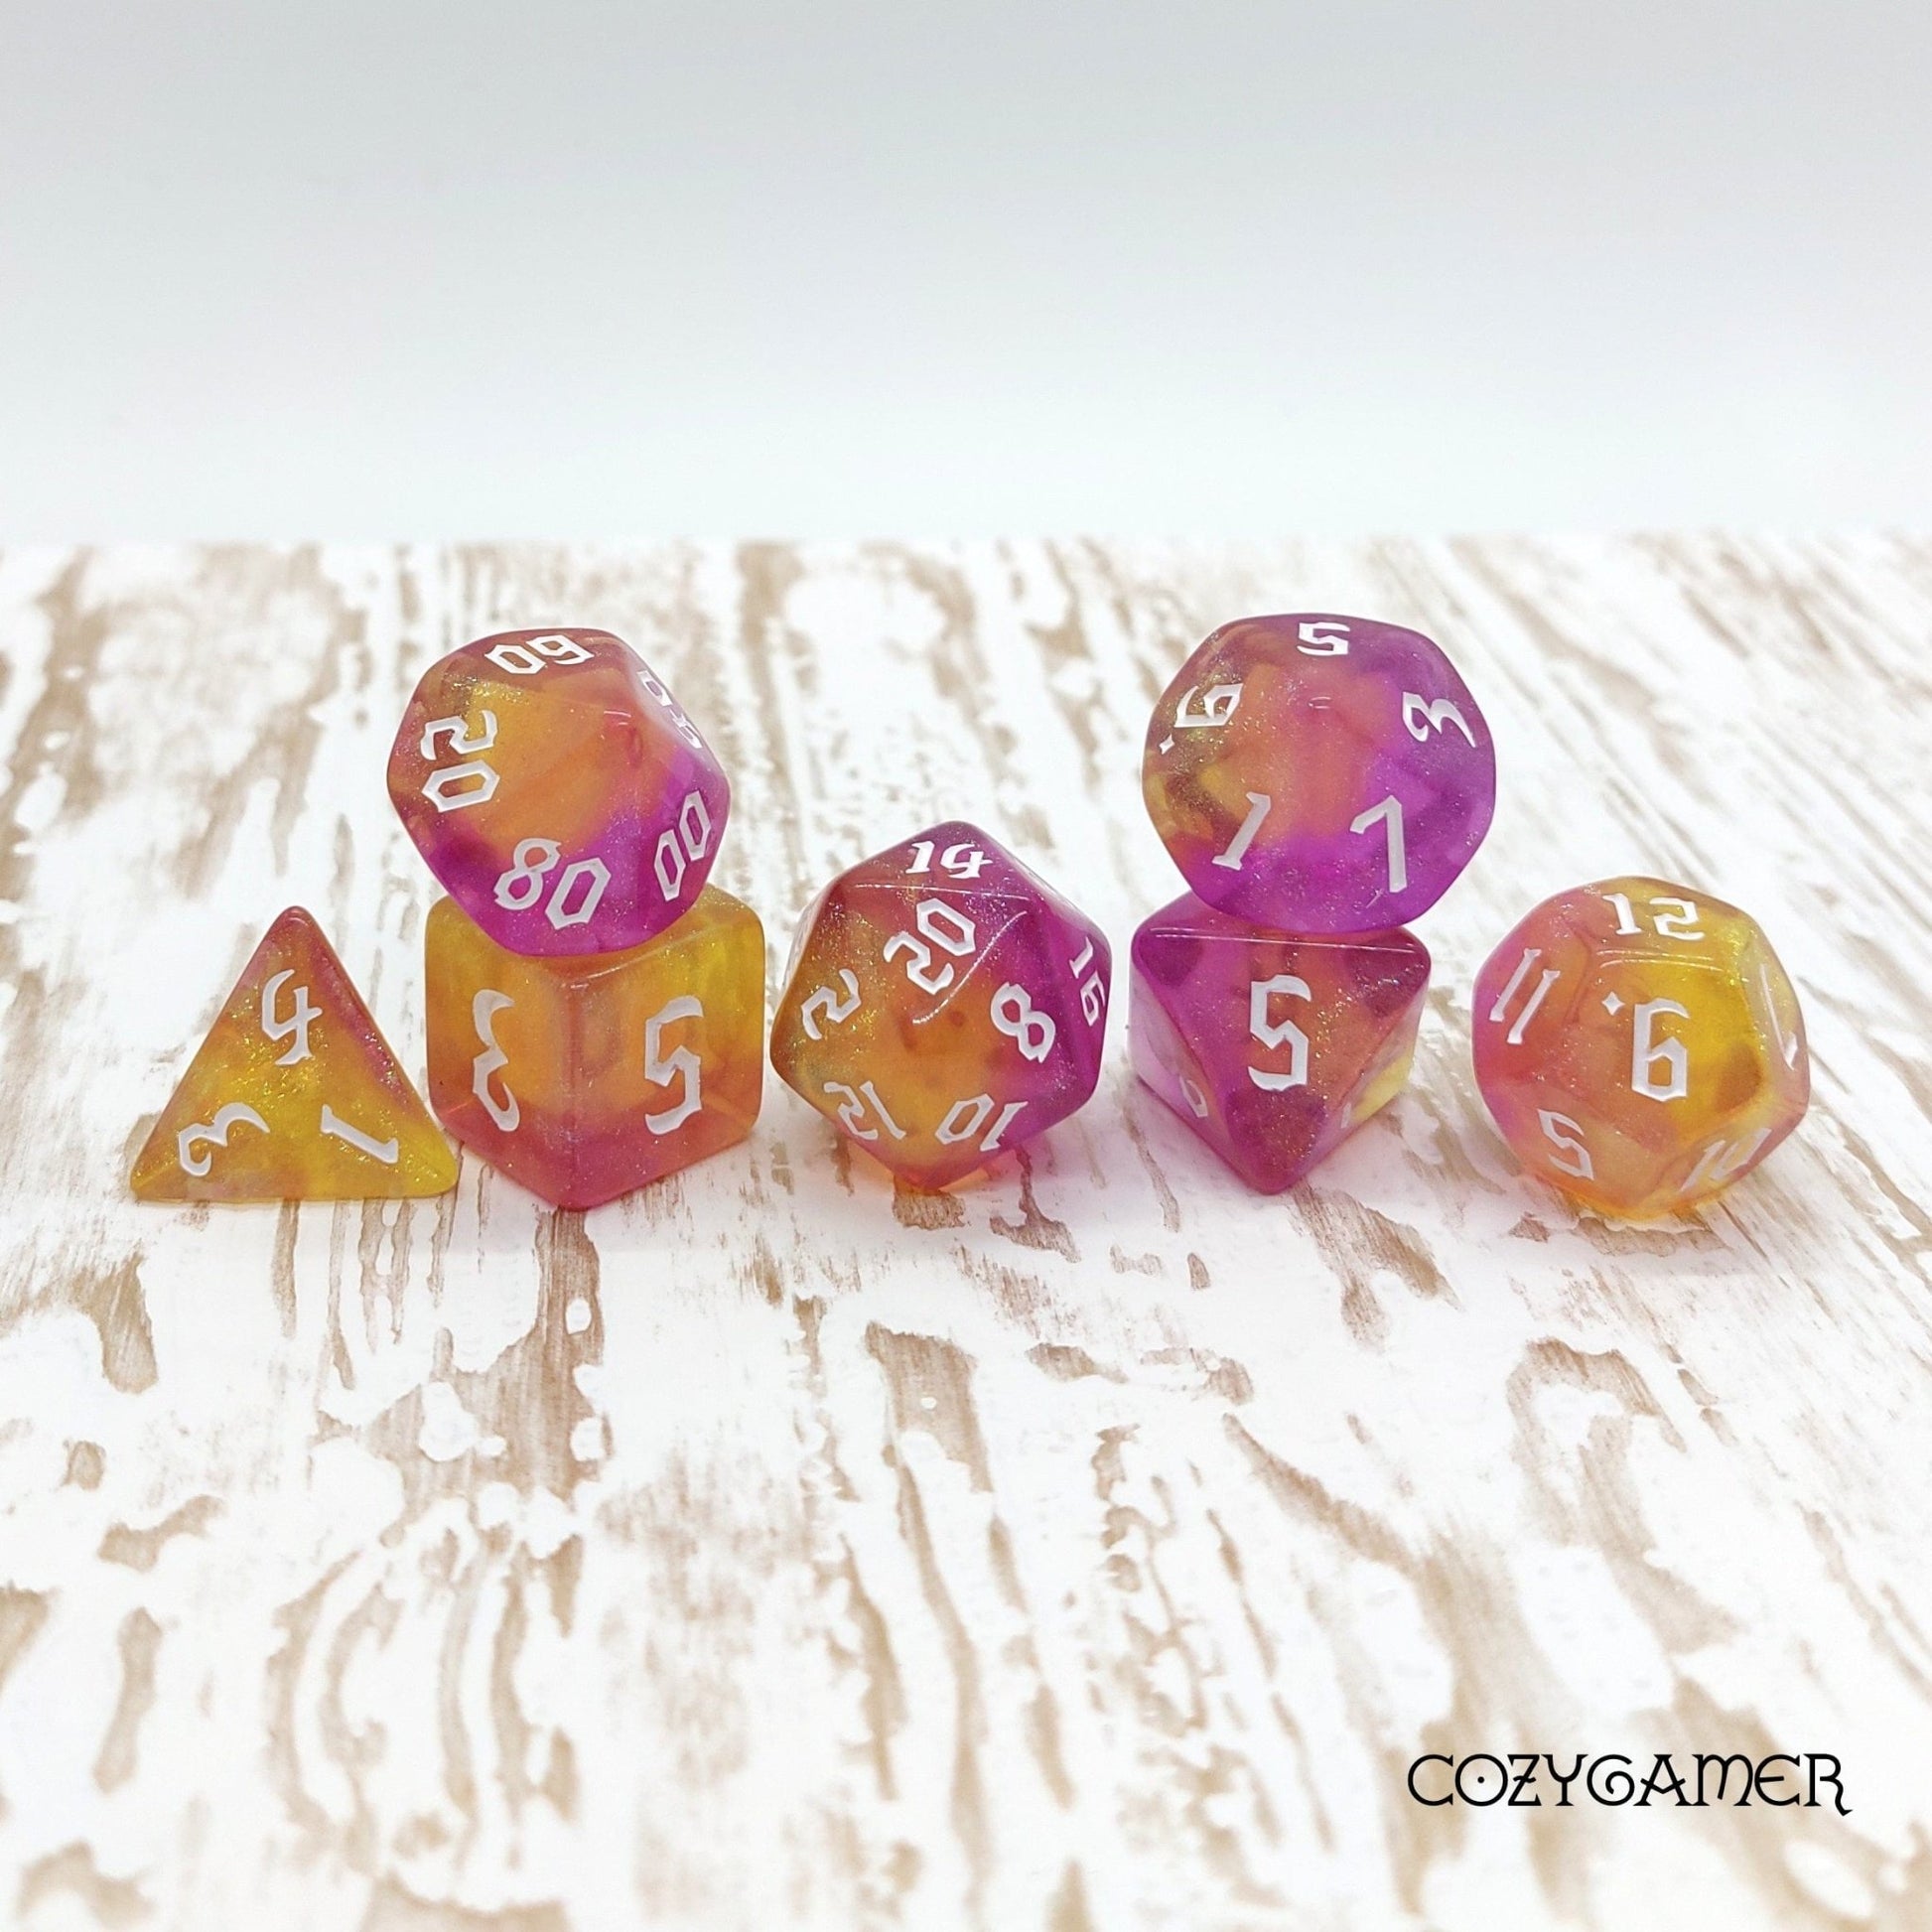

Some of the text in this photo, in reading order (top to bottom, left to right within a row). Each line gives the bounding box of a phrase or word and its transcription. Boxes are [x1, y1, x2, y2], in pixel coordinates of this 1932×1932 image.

[1297, 621, 1351, 656] 5
[420, 709, 500, 812] 20
[1402, 691, 1476, 749] 3
[653, 790, 711, 901] 00
[904, 840, 994, 880] 14
[1212, 791, 1272, 872] 1
[1350, 794, 1407, 894] 7
[492, 837, 612, 930] 80
[1601, 893, 1706, 941] 12
[883, 897, 977, 995] 20
[1068, 936, 1106, 1027] 16
[261, 969, 323, 1065] 4
[800, 969, 862, 1040] 2
[991, 981, 1056, 1063] 8
[1247, 974, 1312, 1092] 5
[1489, 948, 1561, 1045] 11
[644, 994, 705, 1136] 5
[178, 1102, 271, 1176] 3
[320, 1104, 399, 1165] 1
[934, 1093, 1030, 1152] 10
